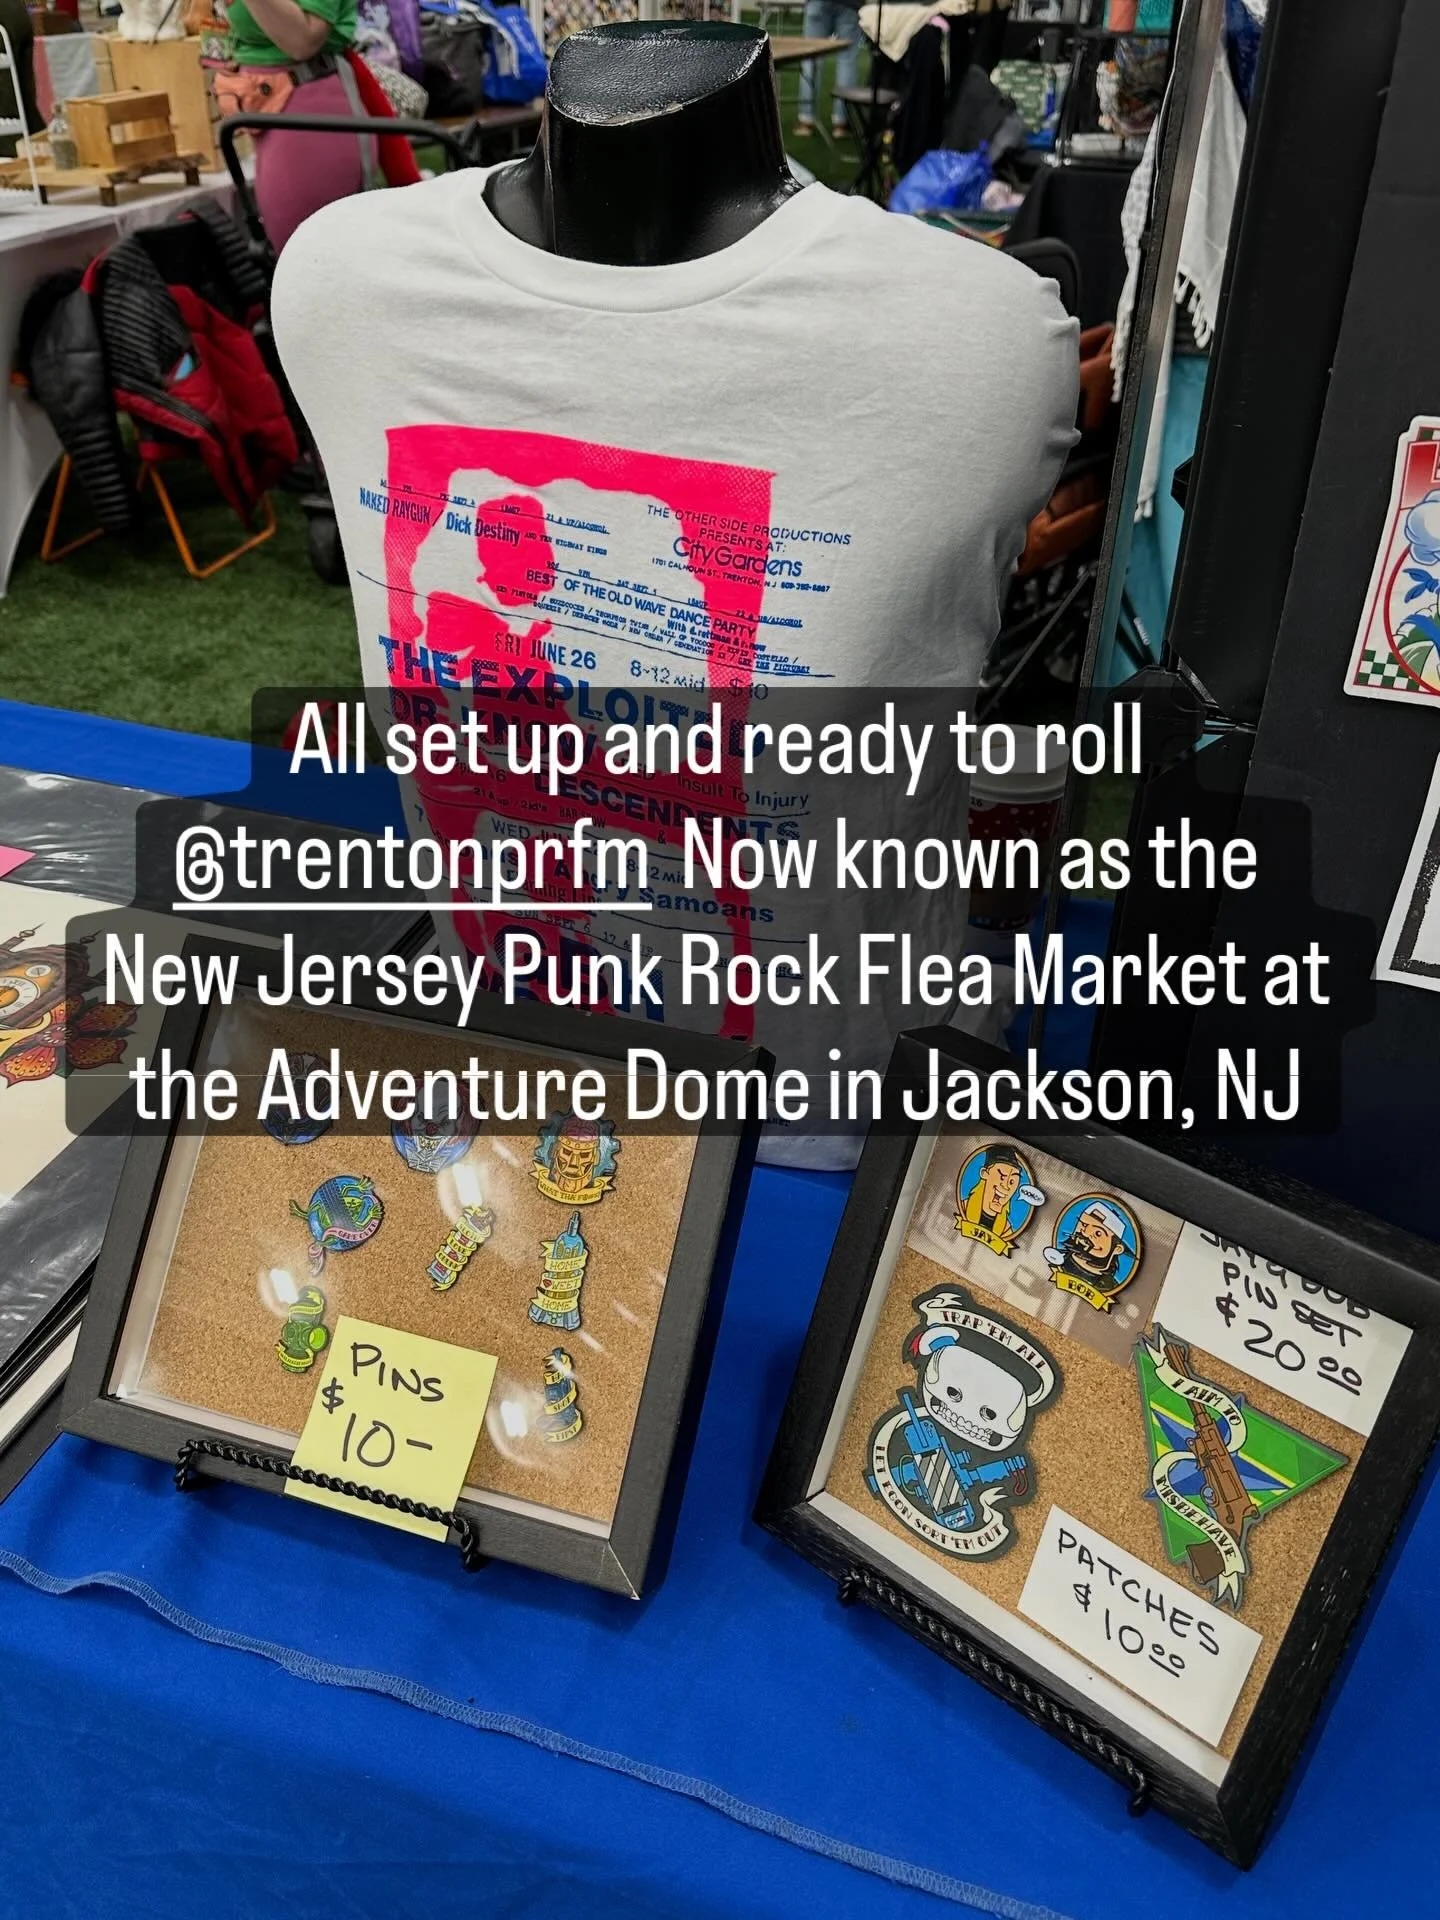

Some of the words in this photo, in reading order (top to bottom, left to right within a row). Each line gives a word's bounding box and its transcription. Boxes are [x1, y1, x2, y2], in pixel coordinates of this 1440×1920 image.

[359, 487, 390, 515] NAKED
[392, 498, 432, 525] RAYGUN
[446, 511, 473, 535] Dick
[474, 517, 520, 547] Destiny
[647, 504, 669, 519] THE
[675, 509, 717, 528] OTHER
[720, 518, 749, 533] SIDE
[753, 525, 851, 545] PRODUCTIONS
[700, 528, 763, 550] PRESENTS
[766, 541, 787, 553] AT:
[668, 561, 706, 575] CALHOUN
[527, 570, 558, 586] BEST
[563, 579, 580, 592] OF
[582, 583, 607, 599] THE
[608, 591, 632, 606] OLD
[635, 597, 666, 616] WAVE
[670, 607, 711, 628] DANCE
[712, 618, 756, 638] PARTY
[667, 619, 686, 633] With
[378, 635, 461, 691] THE
[495, 632, 521, 656] FRI
[530, 639, 567, 666] JUNE
[571, 650, 597, 670] 26
[676, 772, 725, 796] Insult
[731, 785, 749, 803] To
[755, 790, 809, 811] Injury
[491, 817, 530, 839] WED
[638, 886, 775, 923] Samoans
[970, 1228, 997, 1246] JAY
[550, 1259, 582, 1271] HOME
[541, 1298, 573, 1311] HOME
[1067, 1279, 1096, 1301] BOB
[1223, 1261, 1278, 1310] PIN
[1291, 1300, 1363, 1347] SET
[940, 1310, 983, 1329] TRAP
[1016, 1344, 1047, 1373] ALL
[350, 1342, 445, 1402] PINS
[1171, 1377, 1185, 1390] I
[1184, 1386, 1225, 1408] AIM
[1223, 1404, 1242, 1426] TO
[875, 1446, 886, 1473] LET
[882, 1480, 913, 1520] EGON
[914, 1518, 948, 1544] SORT
[977, 1523, 1002, 1547] OUT
[1155, 1474, 1237, 1562] MISBEHAVE
[1058, 1527, 1220, 1656] PATCHES
